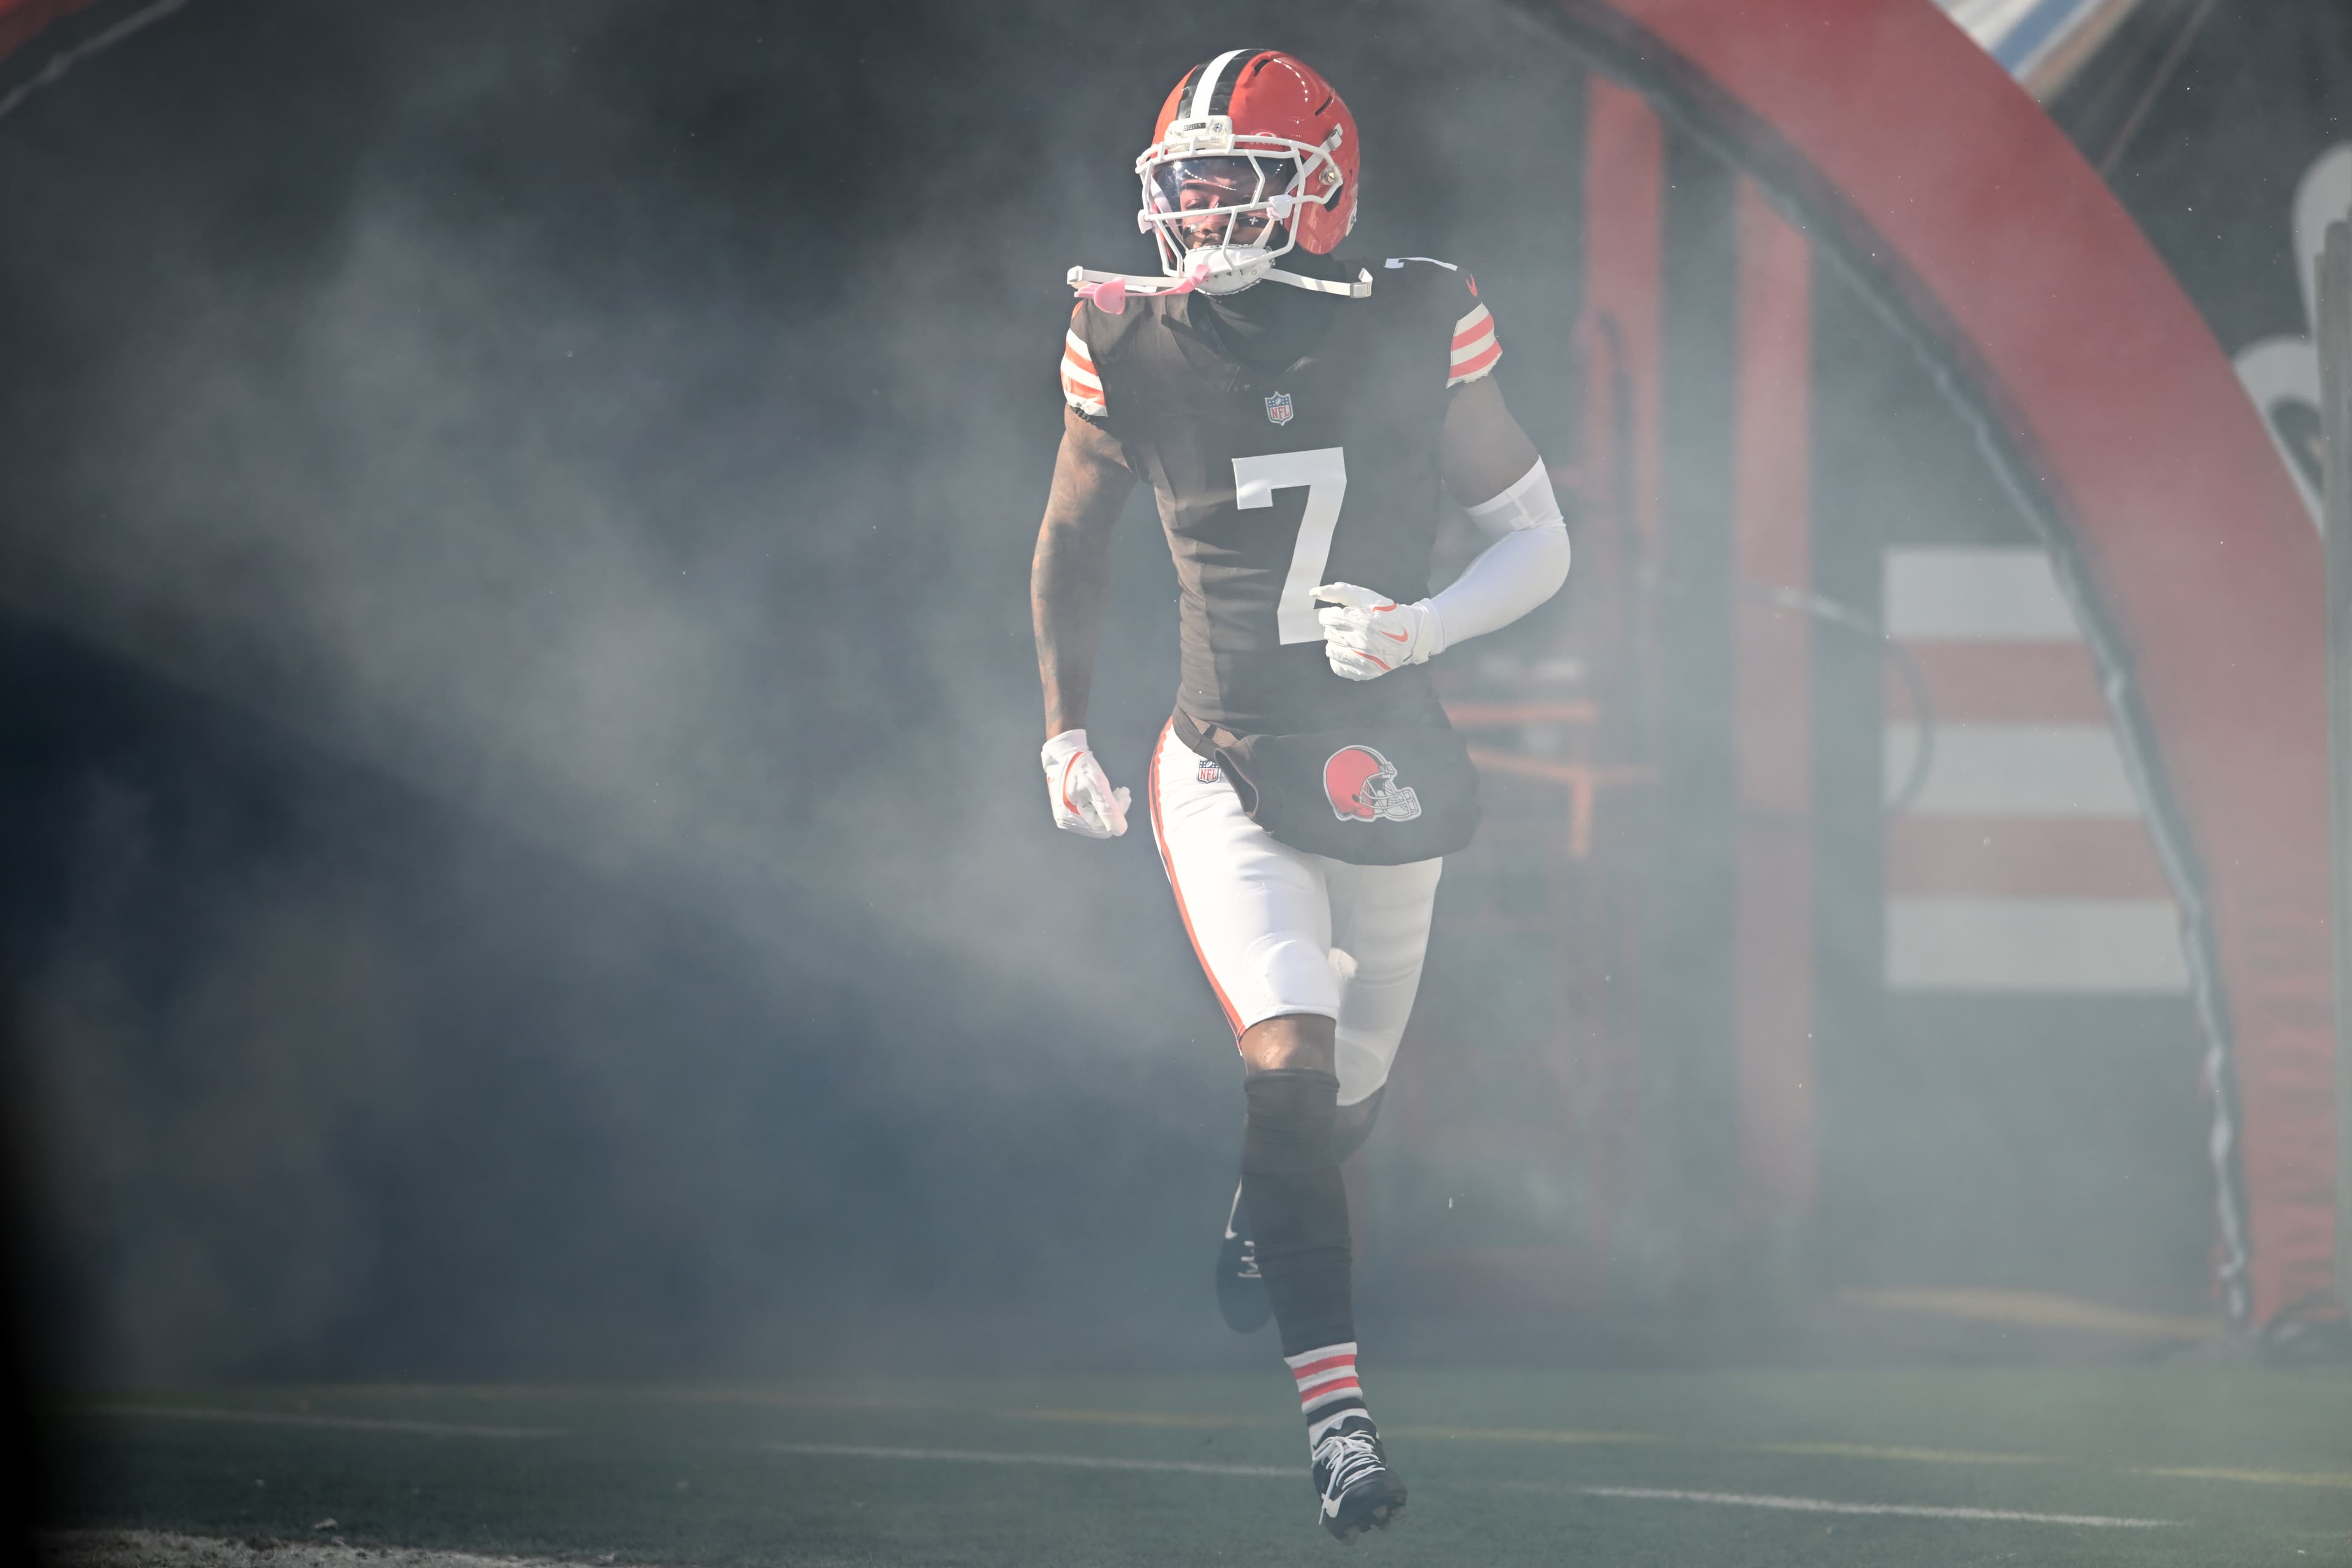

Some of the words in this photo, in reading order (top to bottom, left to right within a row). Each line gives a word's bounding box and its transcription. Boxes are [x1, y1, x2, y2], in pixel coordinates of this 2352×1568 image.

[1271, 406, 1289, 419] NFL
[1232, 447, 1347, 645] 7
[1200, 769, 1216, 781] NFL
